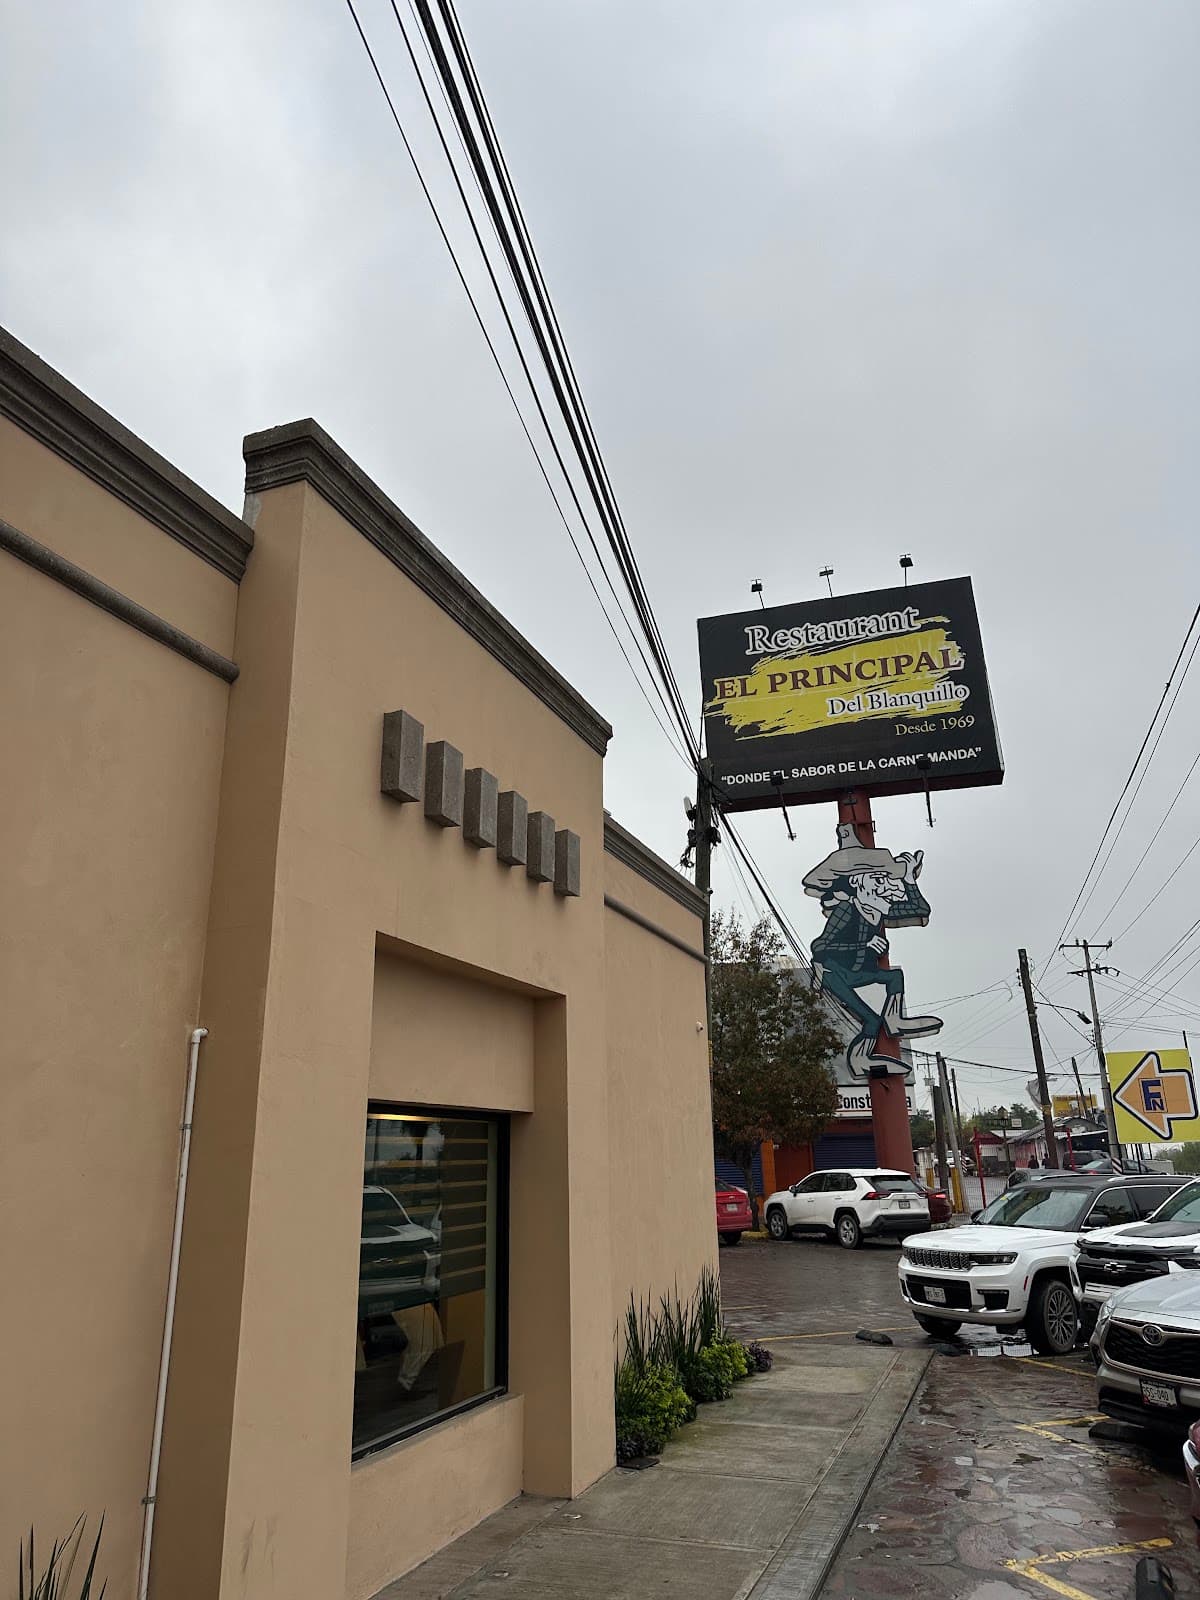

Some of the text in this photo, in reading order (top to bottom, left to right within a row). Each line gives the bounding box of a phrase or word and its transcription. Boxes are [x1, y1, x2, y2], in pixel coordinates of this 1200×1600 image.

[745, 607, 920, 654] Restaurant
[716, 648, 963, 700] EL PRINCIPAL
[828, 681, 970, 717] Del Blanquillo
[895, 715, 975, 736] Desde 1969
[791, 764, 836, 779] SABOR
[838, 761, 857, 773] DE
[858, 759, 876, 771] LA
